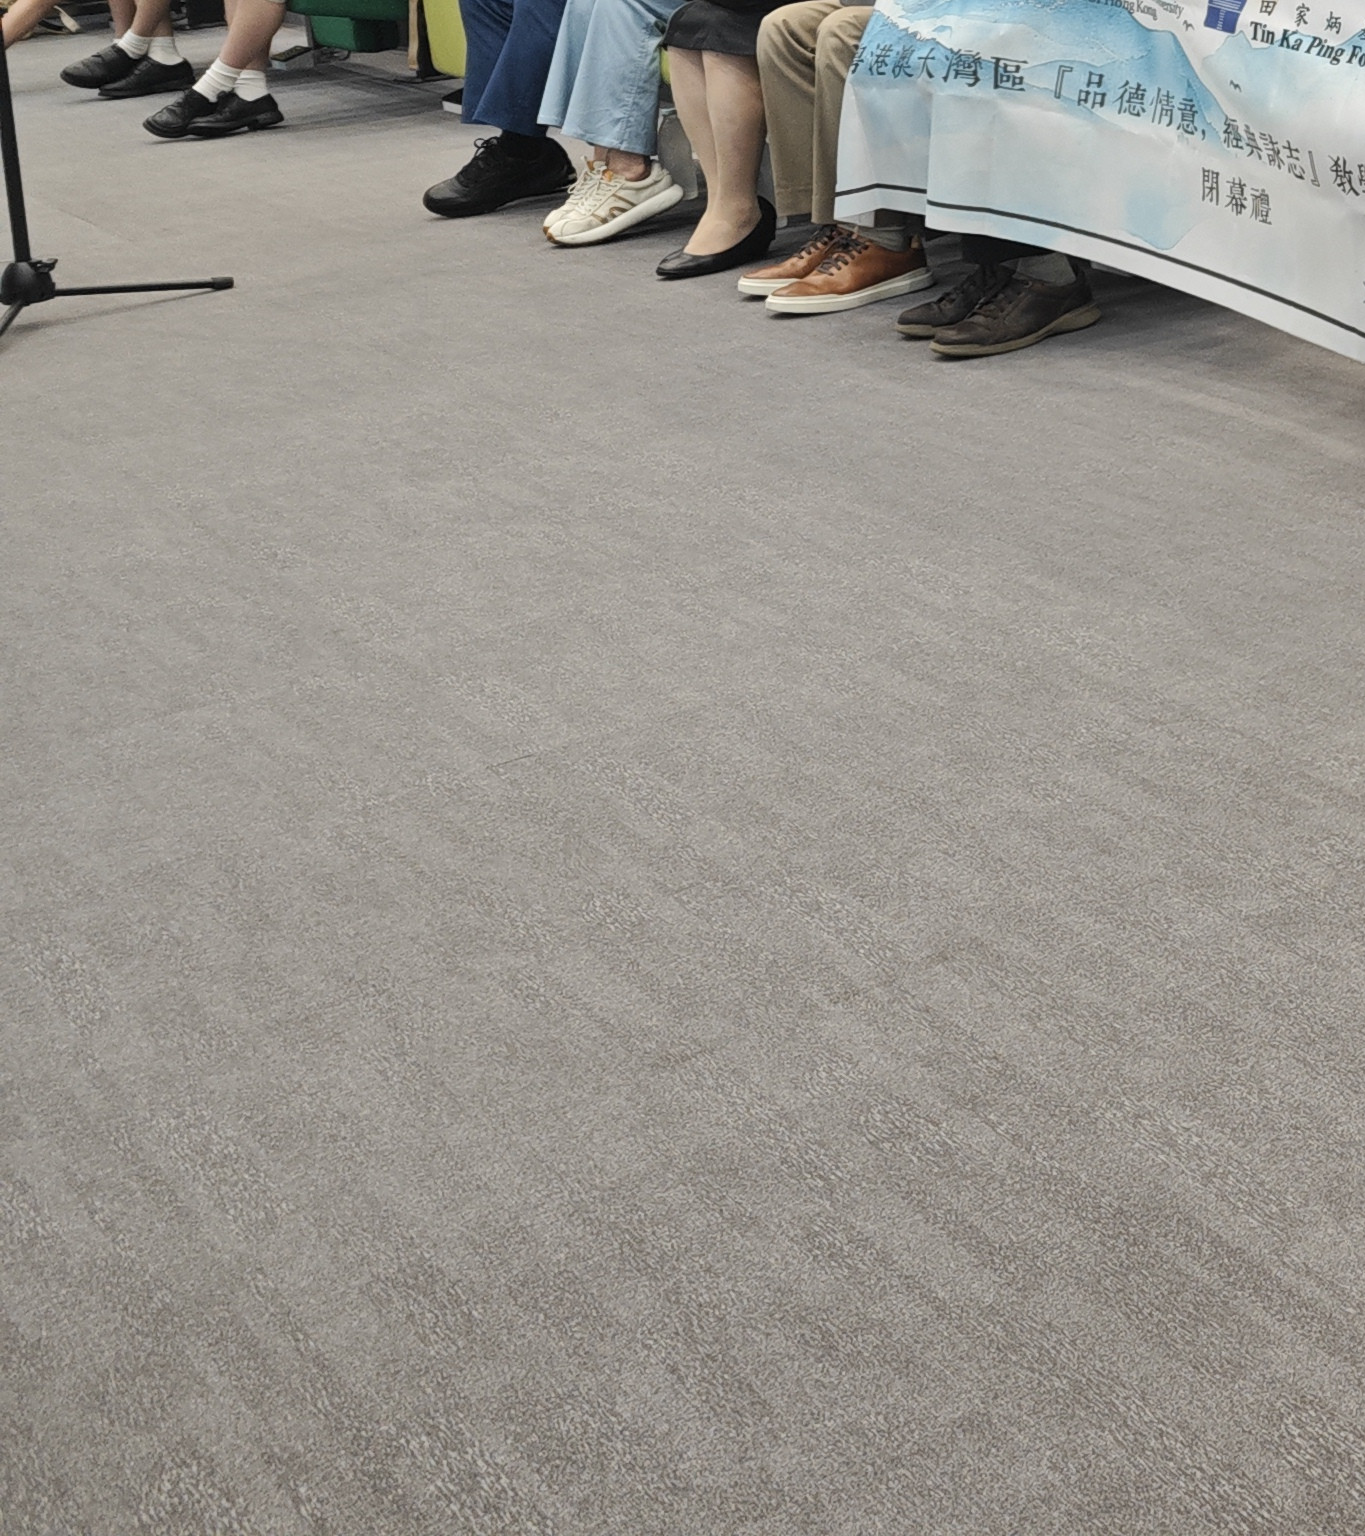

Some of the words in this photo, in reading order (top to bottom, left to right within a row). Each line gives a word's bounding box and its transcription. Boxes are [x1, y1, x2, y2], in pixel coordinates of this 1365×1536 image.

[1136, 0, 1158, 21] Kong
[1250, 20, 1275, 45] Tin
[1279, 29, 1301, 52] Ka
[1303, 36, 1346, 66] Ping
[1201, 166, 1273, 226] 閉幕禮
